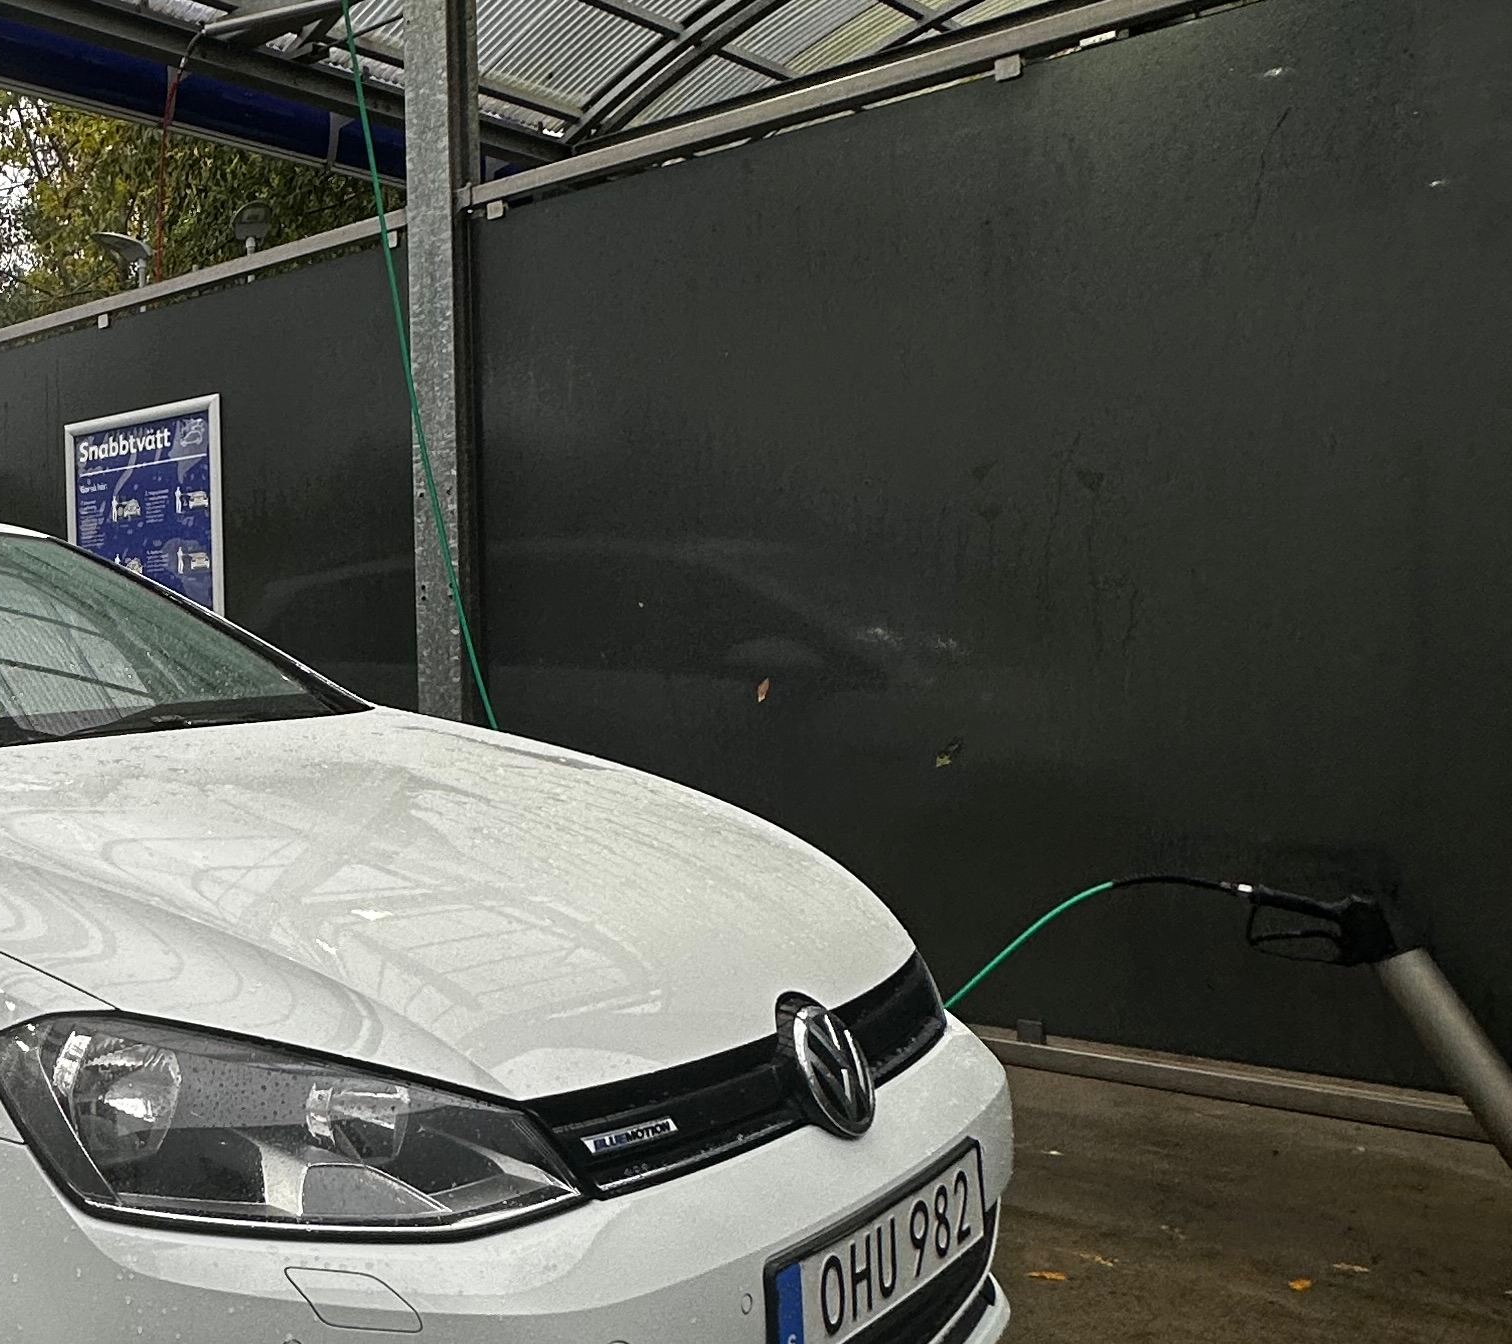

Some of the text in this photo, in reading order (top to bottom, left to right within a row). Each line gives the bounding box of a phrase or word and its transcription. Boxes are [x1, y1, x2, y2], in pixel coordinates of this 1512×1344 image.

[79, 428, 171, 463] Snabbtvätt
[820, 1169, 973, 1336] OHU 982
